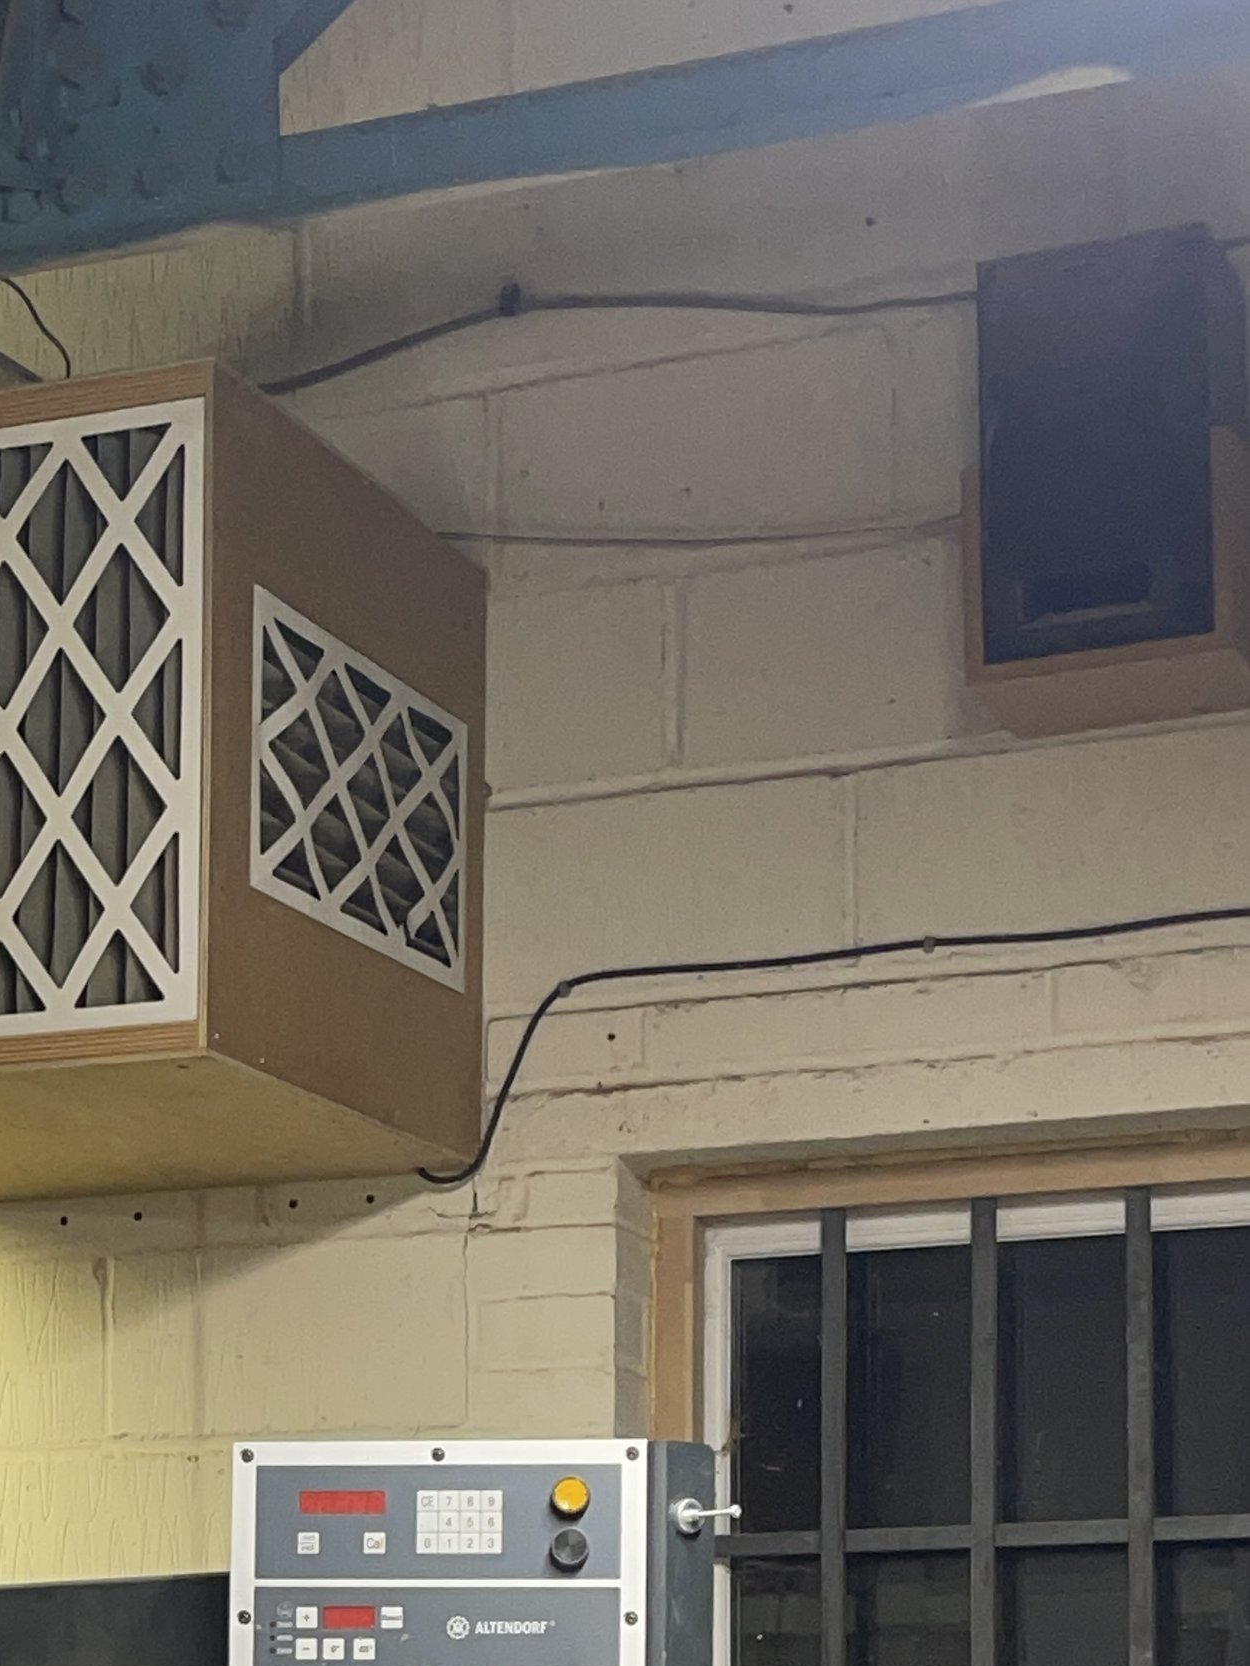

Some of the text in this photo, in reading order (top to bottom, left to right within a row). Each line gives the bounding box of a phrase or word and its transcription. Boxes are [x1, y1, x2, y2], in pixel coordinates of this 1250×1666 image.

[445, 1495, 453, 1507] 7
[467, 1495, 475, 1507] 8
[466, 1516, 474, 1529] 5
[487, 1516, 495, 1529] 6
[423, 1537, 432, 1549] 0
[466, 1537, 474, 1549] 2
[487, 1537, 495, 1549] 3
